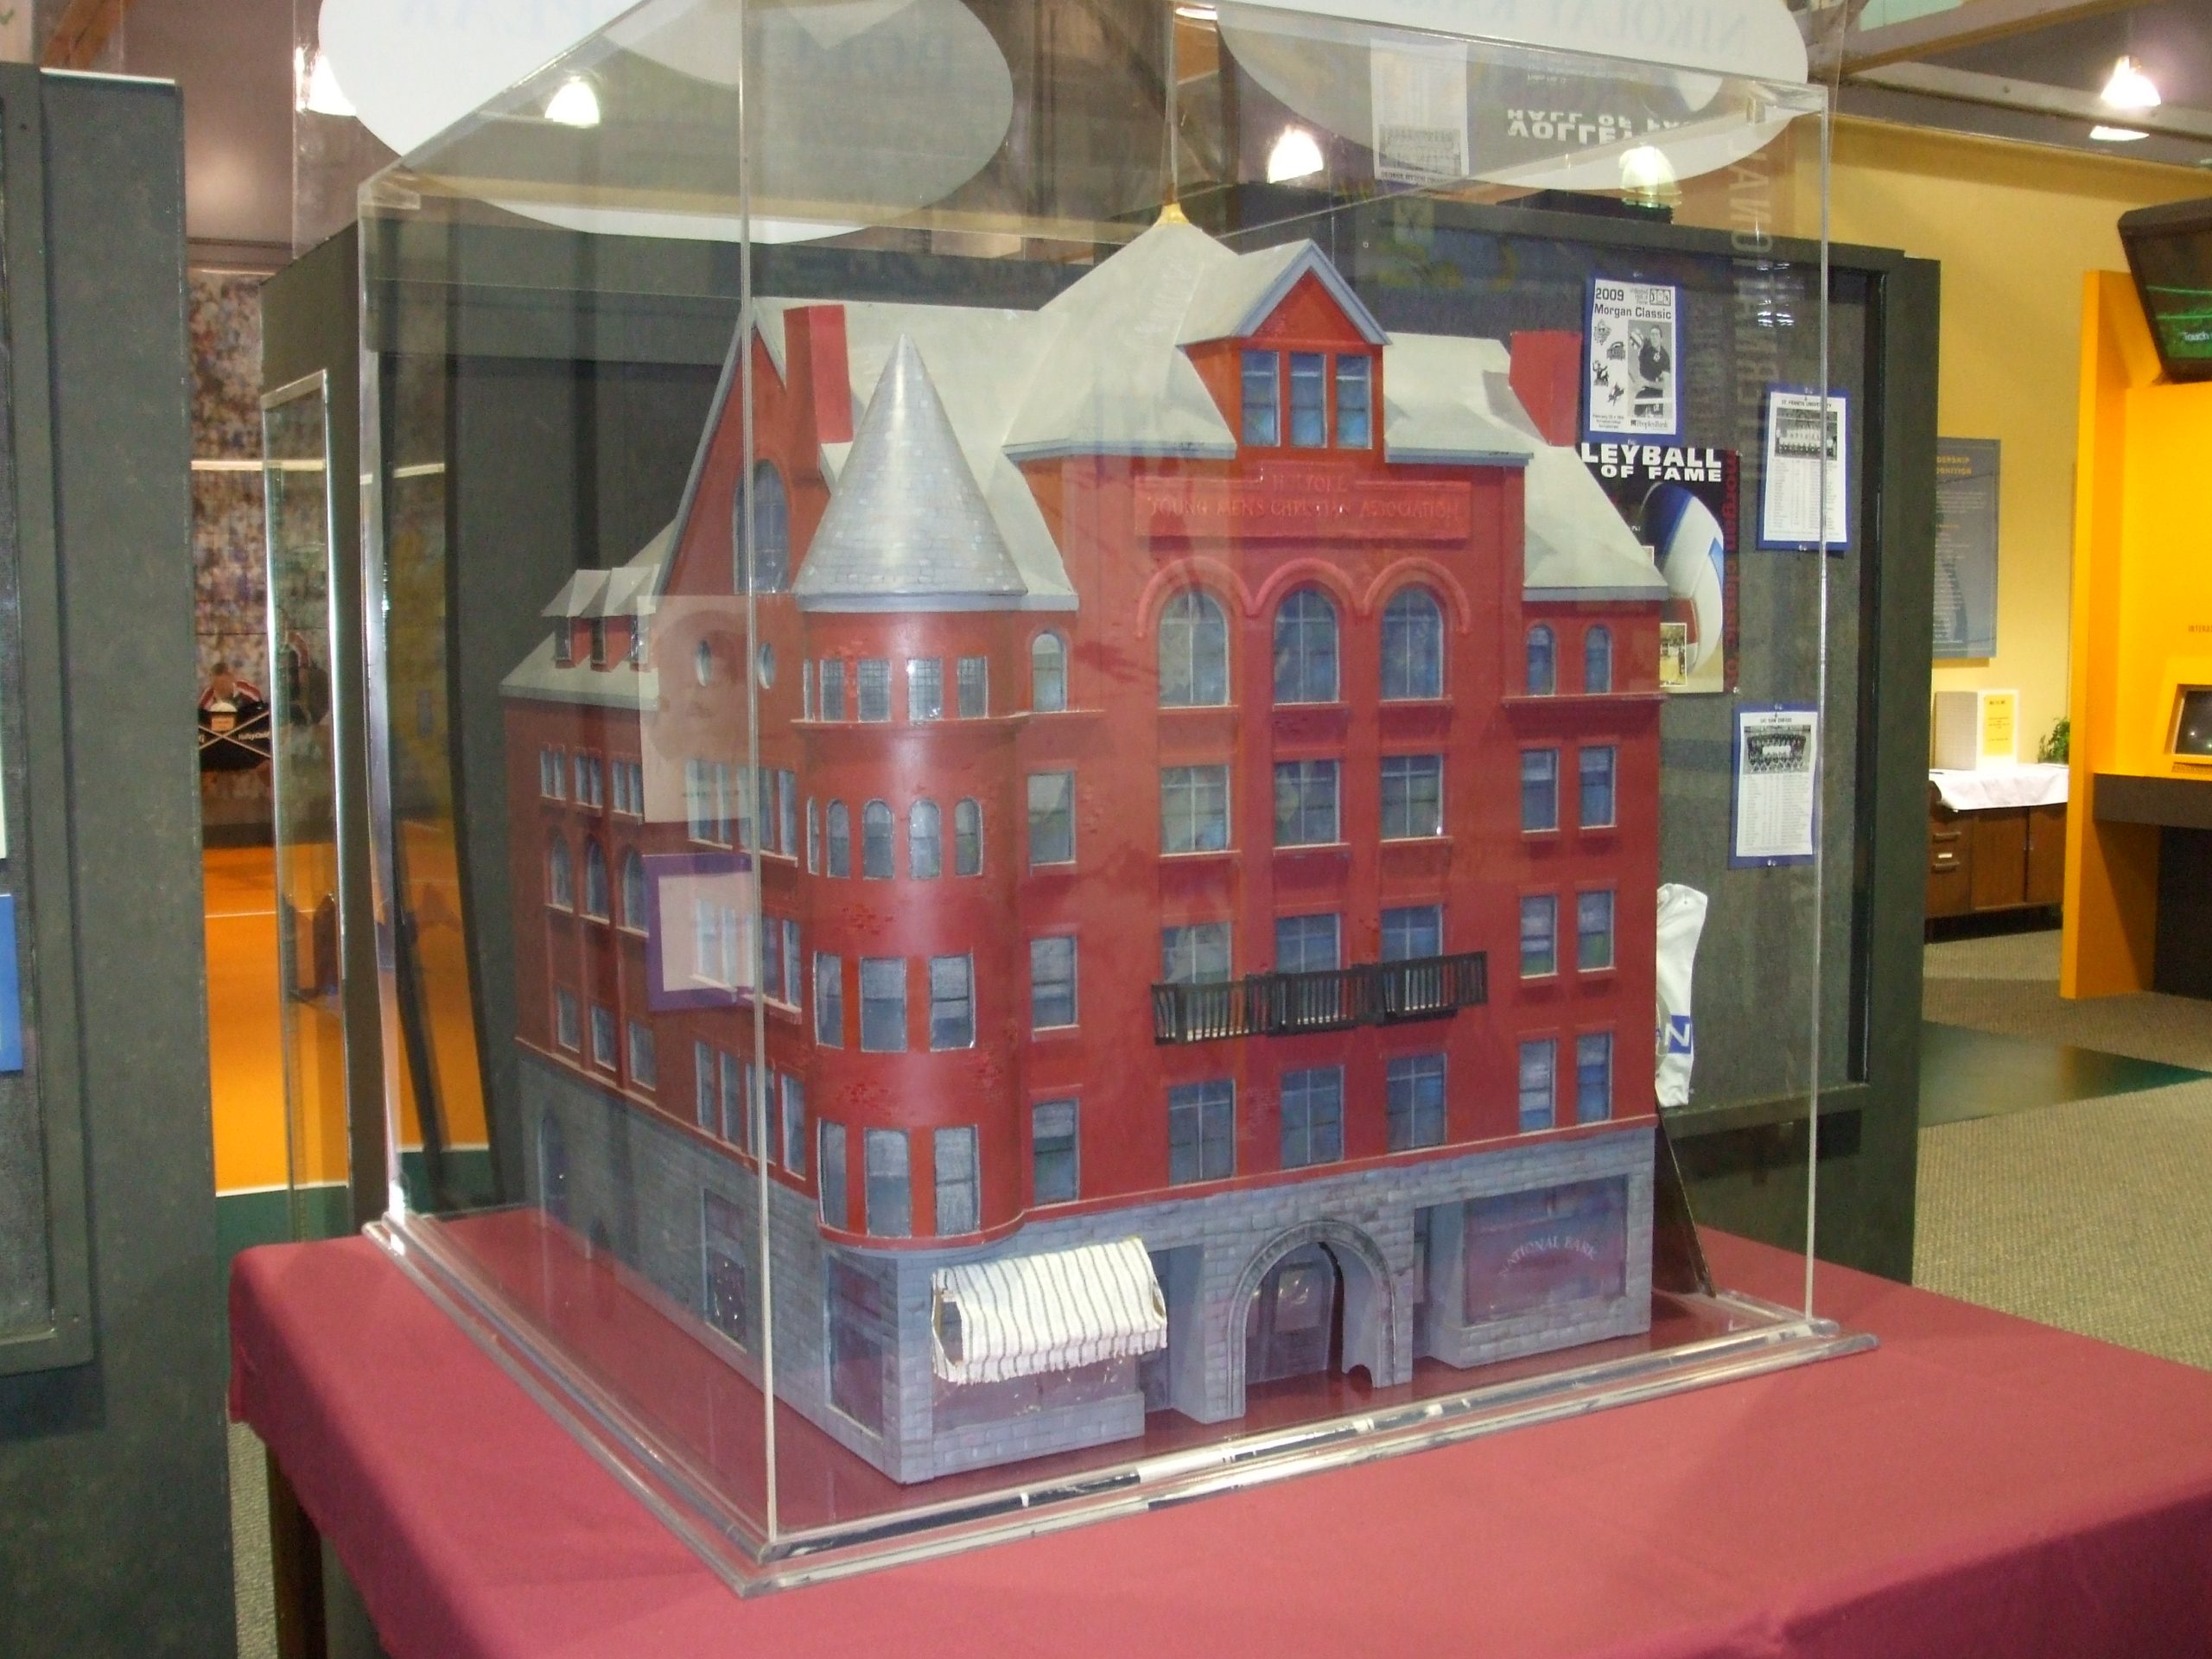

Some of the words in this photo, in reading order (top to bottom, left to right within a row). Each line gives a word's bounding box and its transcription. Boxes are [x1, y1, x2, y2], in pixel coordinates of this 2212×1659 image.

[1595, 288, 1624, 302] 2009
[1594, 303, 1632, 319] Morgan
[1636, 307, 1672, 320] Classic
[1580, 442, 1722, 468] LEYBALL
[1600, 465, 1634, 479] OF
[1648, 467, 1721, 482] FAME
[1272, 474, 1348, 493] HLYOKE
